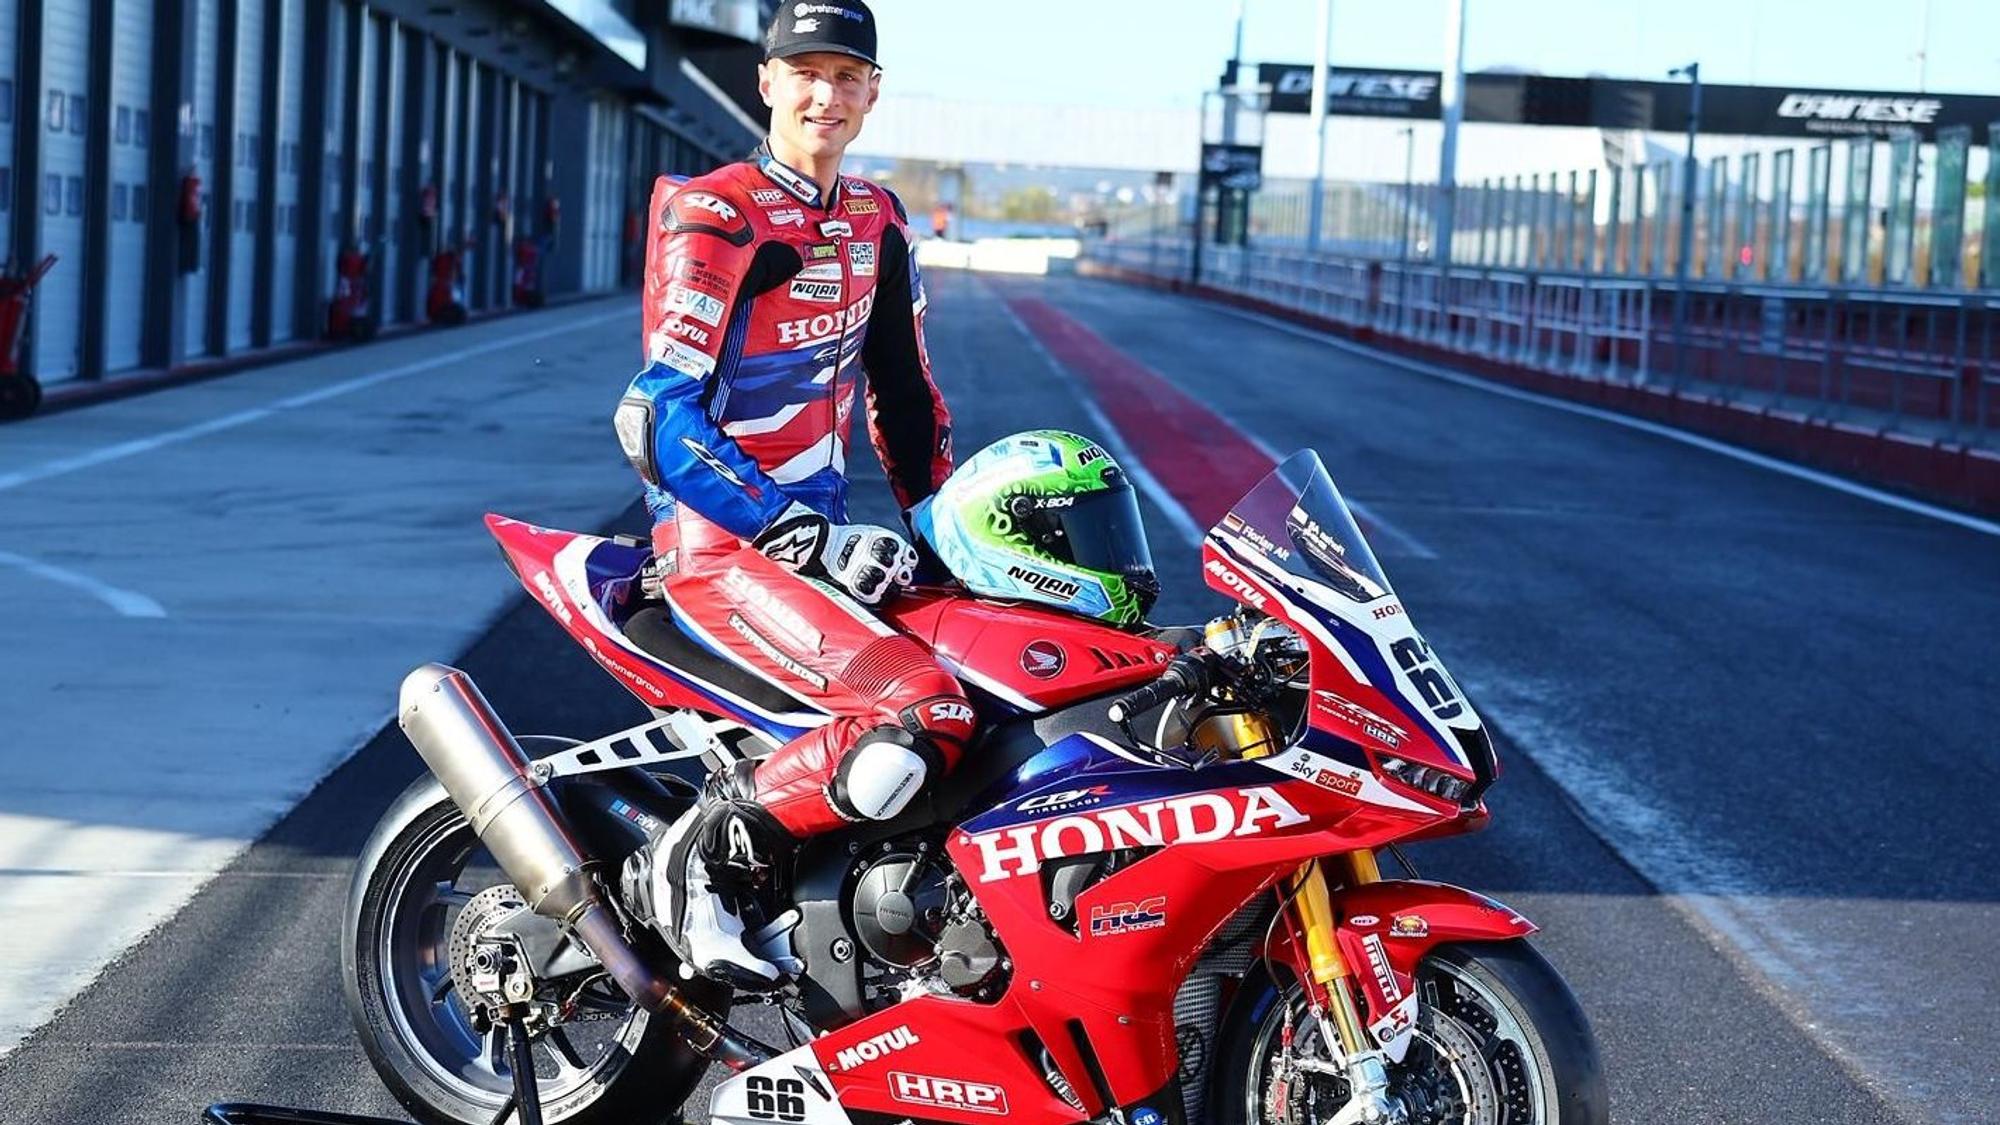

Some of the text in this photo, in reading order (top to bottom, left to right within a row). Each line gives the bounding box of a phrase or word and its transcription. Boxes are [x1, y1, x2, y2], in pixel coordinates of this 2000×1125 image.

[1277, 70, 1438, 100] DINESE
[850, 244, 873, 254] EURO
[792, 283, 840, 300] NOLAN
[778, 293, 873, 344] HOND
[1242, 525, 1275, 552] Florian
[1273, 546, 1290, 562] Alt
[1008, 566, 1081, 601] NOLAN
[1205, 560, 1269, 609] MOTUL
[1372, 604, 1402, 620] HON
[597, 651, 665, 699] brehmergroup
[1365, 724, 1399, 747] HRP
[1291, 761, 1360, 794] sky sport
[1027, 797, 1100, 816] FIREBLADE
[973, 786, 1310, 884] HONDA
[1090, 896, 1166, 933] HRC
[1362, 933, 1402, 1004] PIRELLI
[836, 1025, 920, 1072] MOTUL
[746, 1075, 806, 1122] 66
[897, 1074, 997, 1105] HRP
